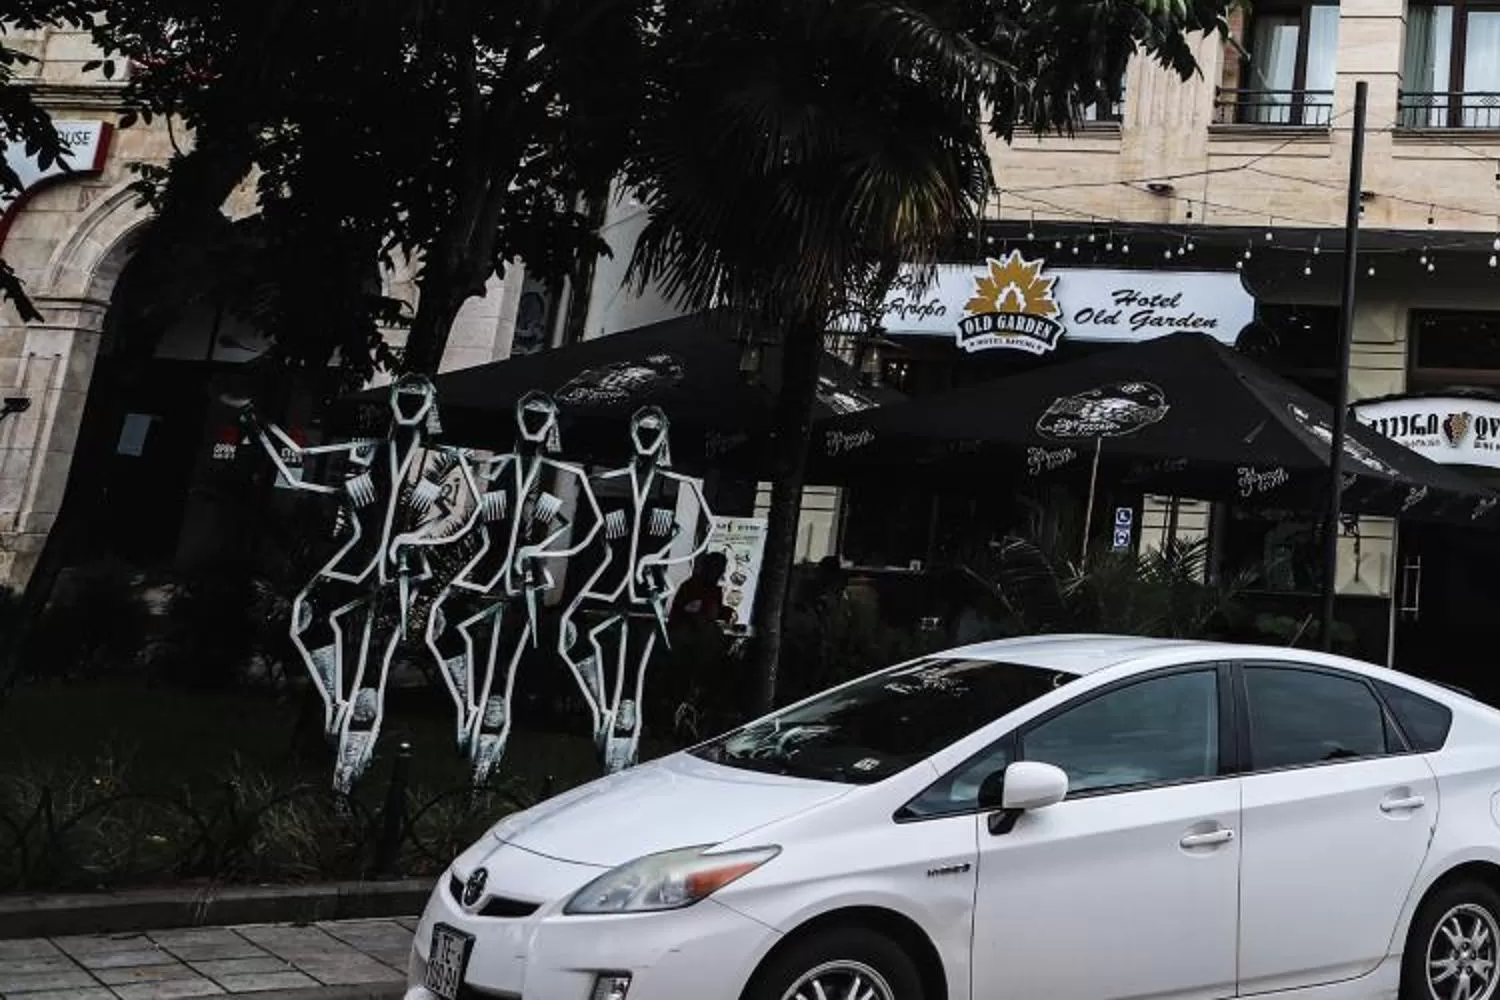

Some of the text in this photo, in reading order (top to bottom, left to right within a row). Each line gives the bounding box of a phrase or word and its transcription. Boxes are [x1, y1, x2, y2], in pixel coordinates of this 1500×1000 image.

[1111, 289, 1183, 308] Hotel
[964, 314, 1053, 338] OLD GARDEN
[1074, 307, 1218, 331] Old Garden
